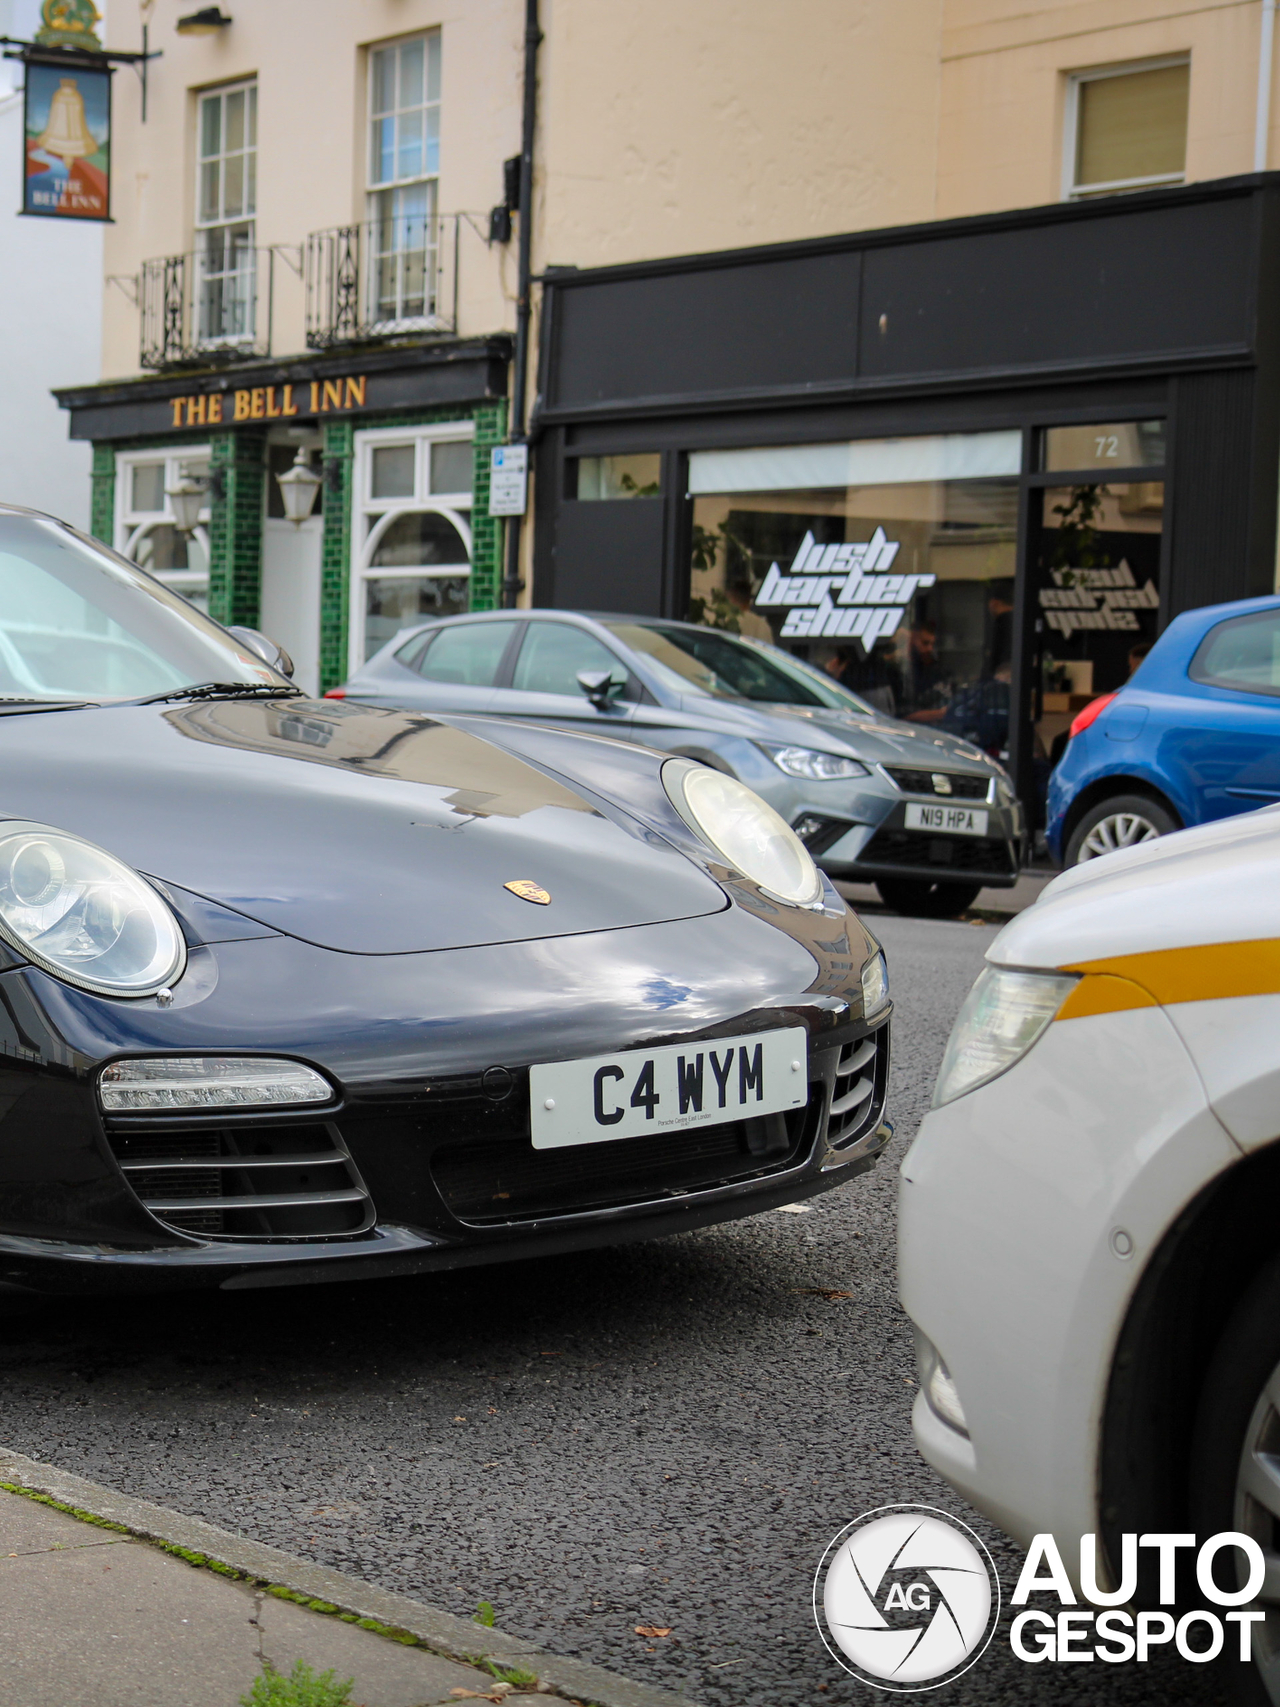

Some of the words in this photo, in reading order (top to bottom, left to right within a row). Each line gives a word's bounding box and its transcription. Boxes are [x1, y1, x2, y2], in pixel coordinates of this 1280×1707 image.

[33, 191, 67, 206] BELL
[72, 195, 101, 208] INN
[54, 179, 81, 193] THE
[170, 393, 223, 427] THE
[233, 384, 299, 421] BELL
[310, 375, 367, 413] INN
[1094, 435, 1118, 458] 72
[790, 525, 900, 573] lush
[755, 561, 937, 606] barber
[780, 590, 905, 653] shop
[947, 811, 973, 829] HPA
[593, 1060, 660, 1126] C4
[677, 1042, 764, 1115] WYM
